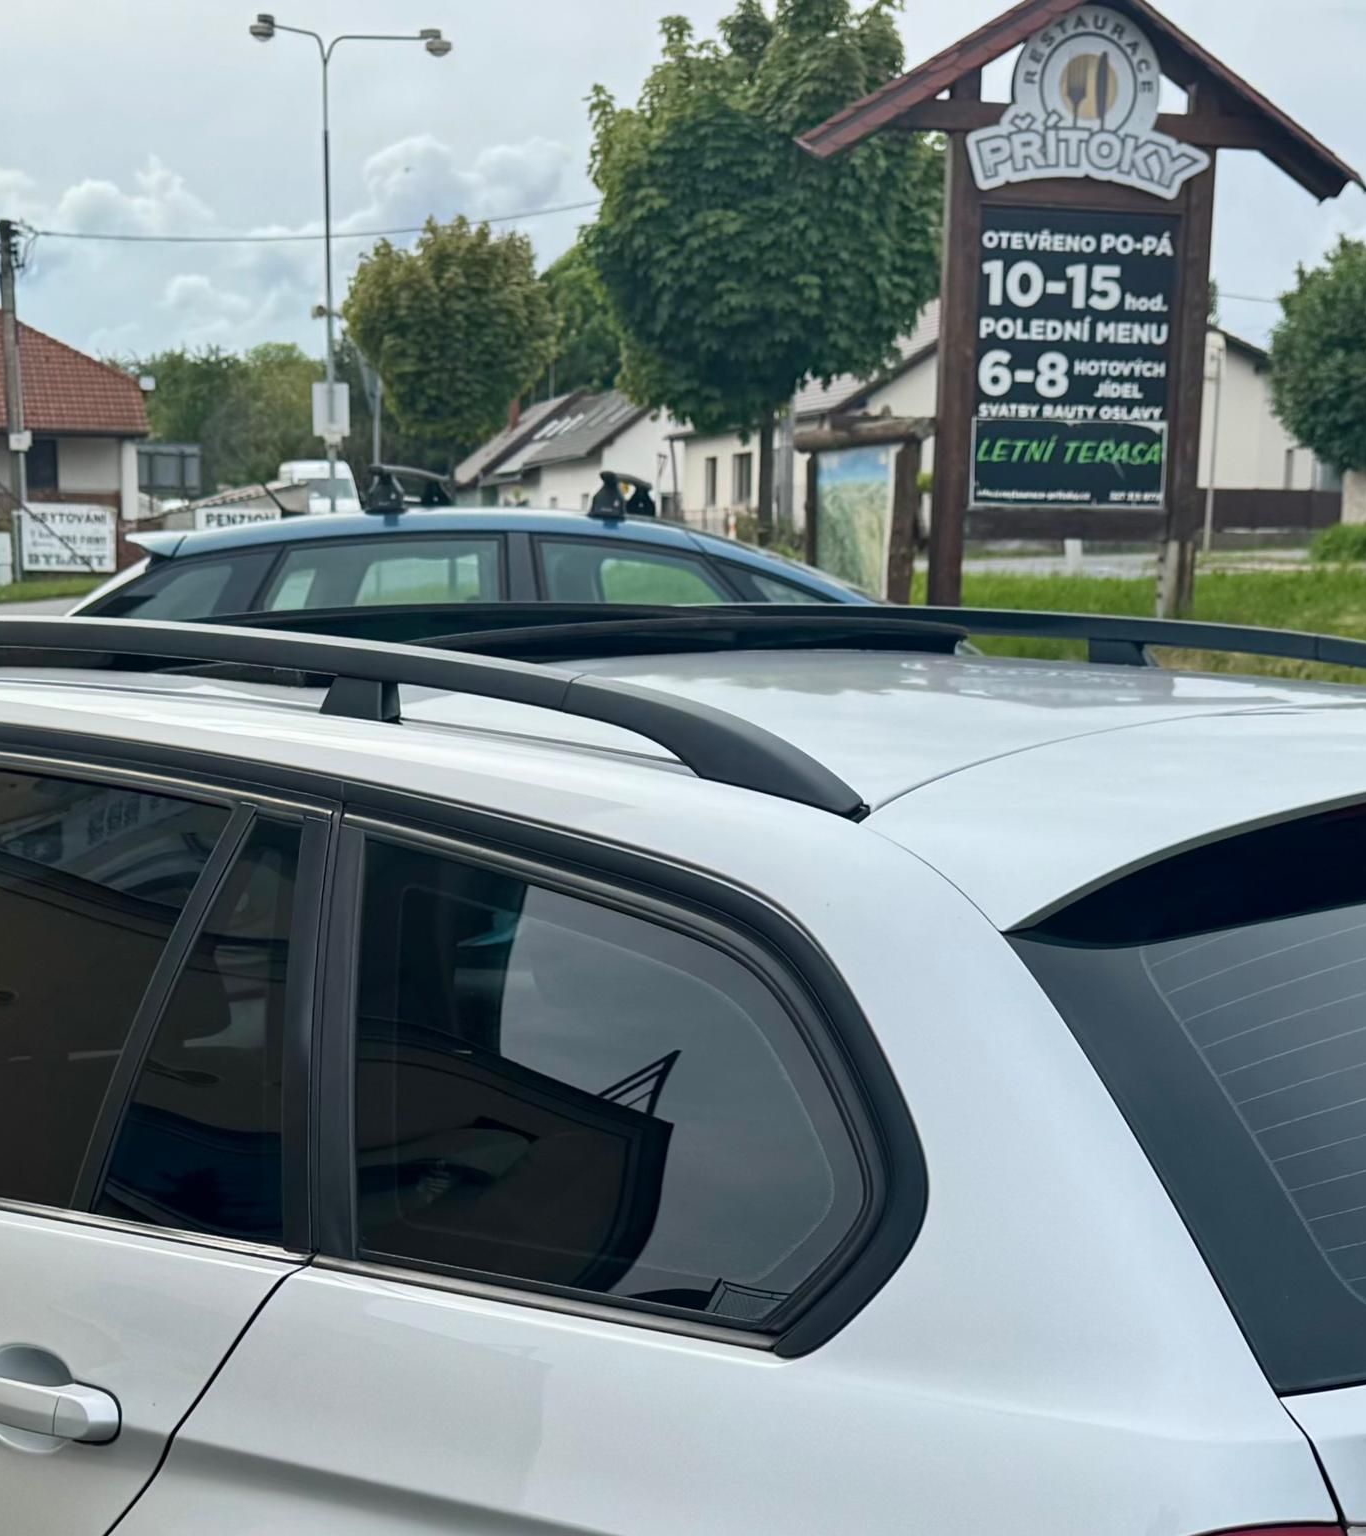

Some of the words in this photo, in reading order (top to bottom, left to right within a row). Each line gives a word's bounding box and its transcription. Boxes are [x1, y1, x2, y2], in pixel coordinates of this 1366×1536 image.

[1024, 15, 1154, 94] RESTAURACE
[975, 110, 1200, 189] PŘÍTOKY
[982, 229, 1097, 253] OTEVŘENO
[1100, 231, 1174, 256] PO-PÁ
[982, 259, 1122, 311] 10-15
[1124, 292, 1168, 311] hod.
[979, 316, 1092, 342] POLEDNÍ
[1096, 322, 1168, 345] MENU
[978, 348, 1069, 398] 6-8
[1073, 357, 1166, 378] HOTOVÝCH
[1094, 378, 1143, 399] JÍDEL
[978, 403, 1039, 418] SVATBY
[1042, 404, 1096, 419] RAUTY
[1099, 405, 1163, 420] OSLAVY
[976, 434, 1059, 463] LETNÍ
[1063, 439, 1162, 465] TERASA
